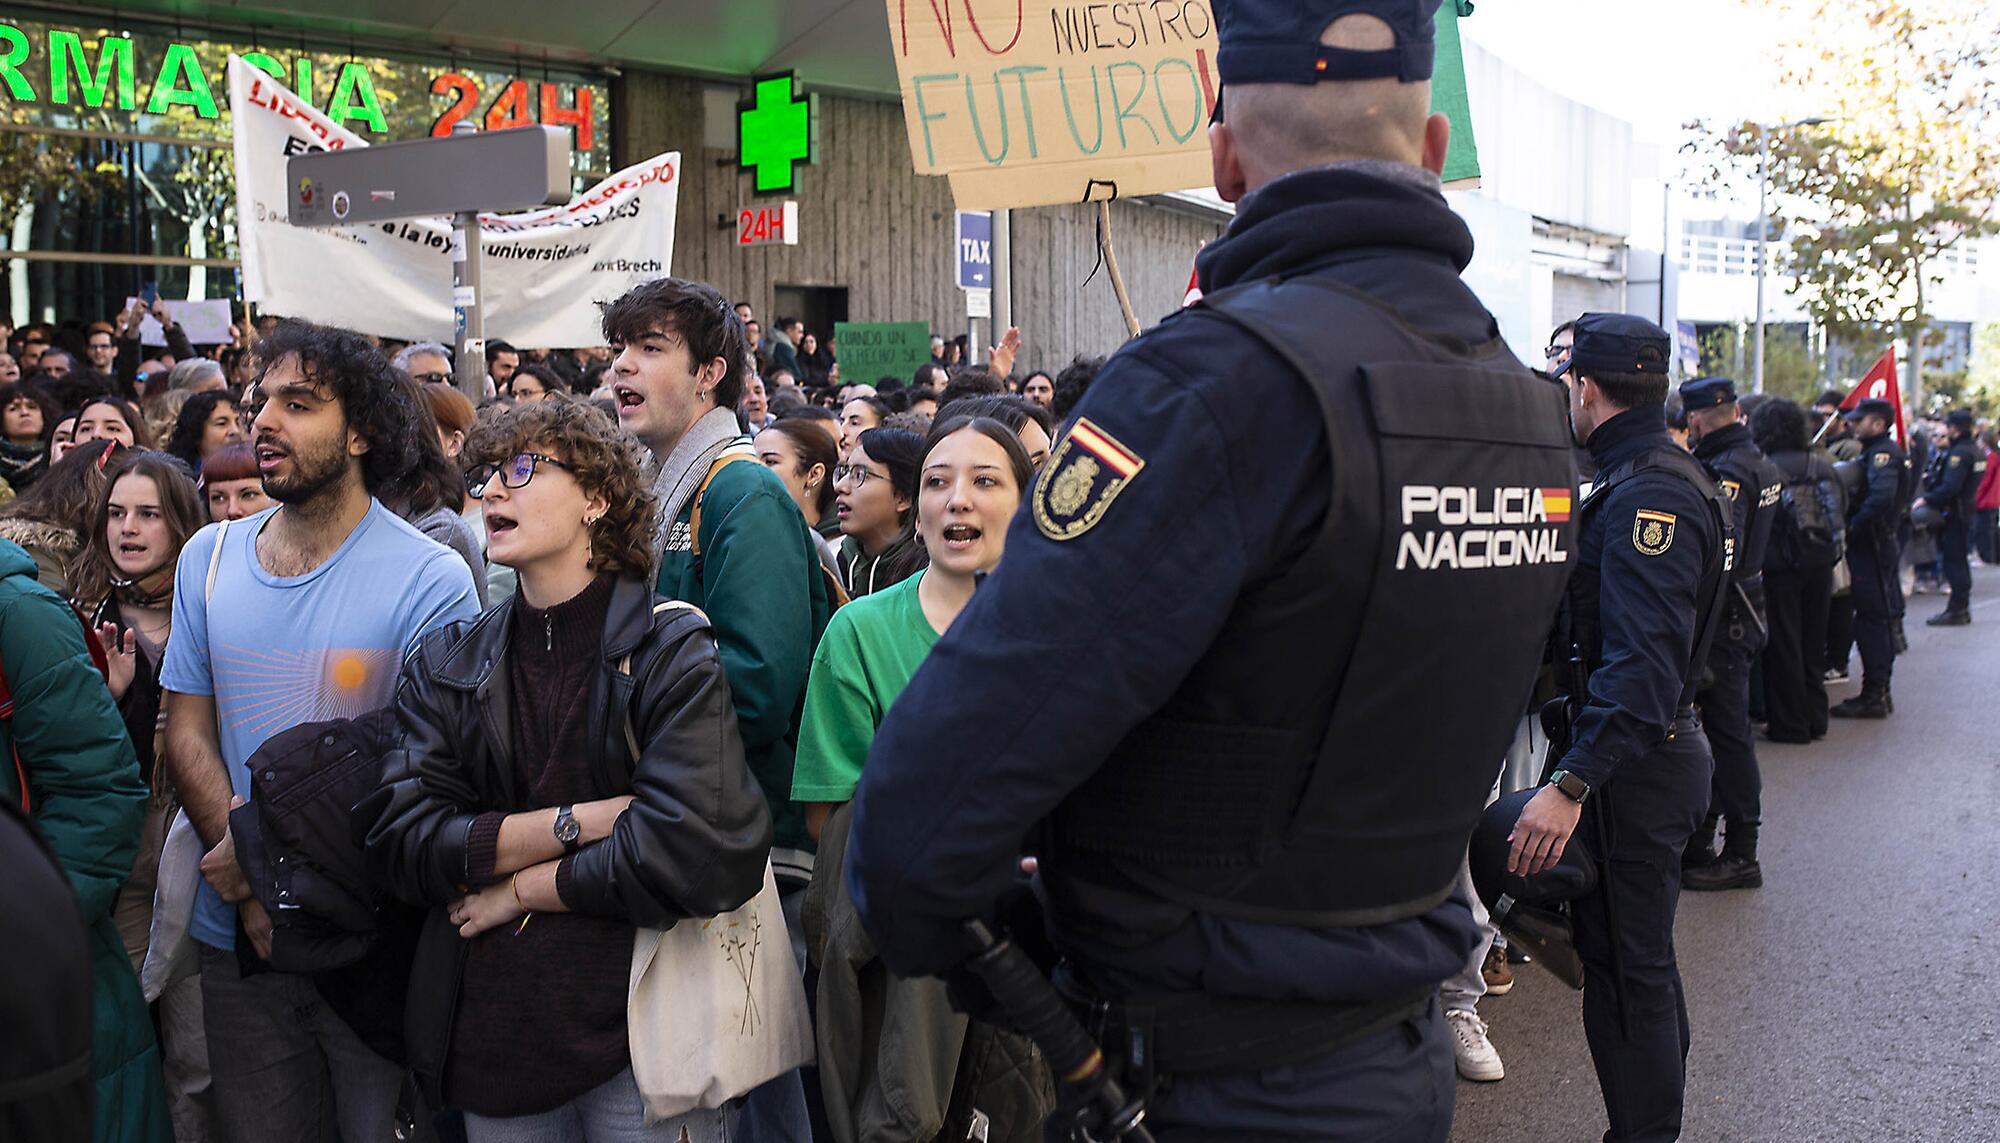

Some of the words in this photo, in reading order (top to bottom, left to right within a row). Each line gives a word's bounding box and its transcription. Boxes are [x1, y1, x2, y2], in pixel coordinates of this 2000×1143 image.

[1051, 0, 1210, 56] NUESTRO
[429, 73, 593, 150] 24H
[400, 223, 420, 243] la
[740, 208, 784, 244] 24H
[1396, 528, 1568, 571] NACIONAL
